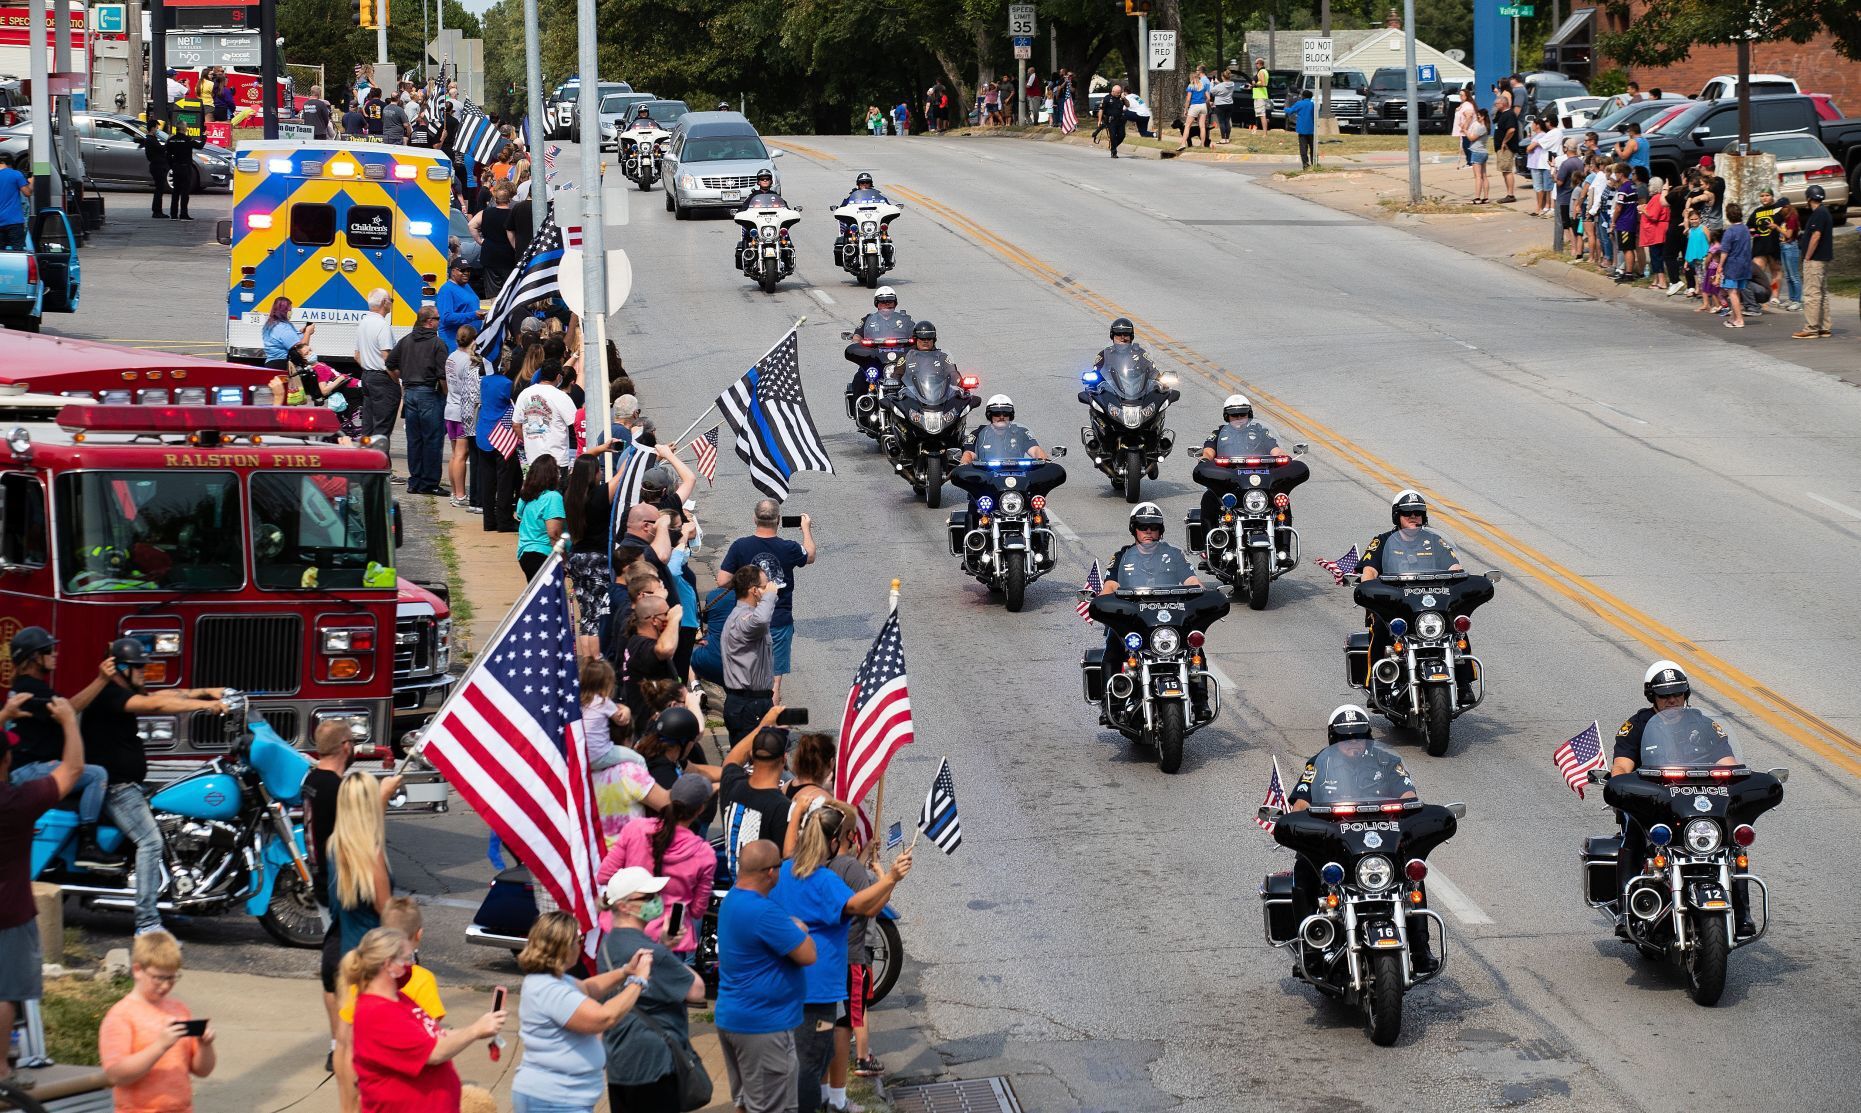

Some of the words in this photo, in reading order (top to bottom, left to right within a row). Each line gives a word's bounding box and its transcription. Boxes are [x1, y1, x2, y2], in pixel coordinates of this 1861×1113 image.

[1500, 7, 1518, 15] Valley
[1013, 21, 1032, 32] 35
[1304, 42, 1314, 50] DO
[1318, 42, 1332, 50] NOT
[1305, 54, 1330, 62] BLOCK
[212, 129, 224, 138] Air
[351, 224, 388, 232] Children's
[302, 310, 366, 322] AMBULANC
[164, 454, 260, 467] RALSTON
[272, 454, 322, 468] FIRE
[1404, 587, 1450, 596] POLICE
[1140, 602, 1186, 612] POLICE
[1670, 786, 1730, 798] POLICE
[1340, 821, 1400, 834] POLICE
[1704, 890, 1722, 899] 12
[1377, 928, 1394, 938] 16
